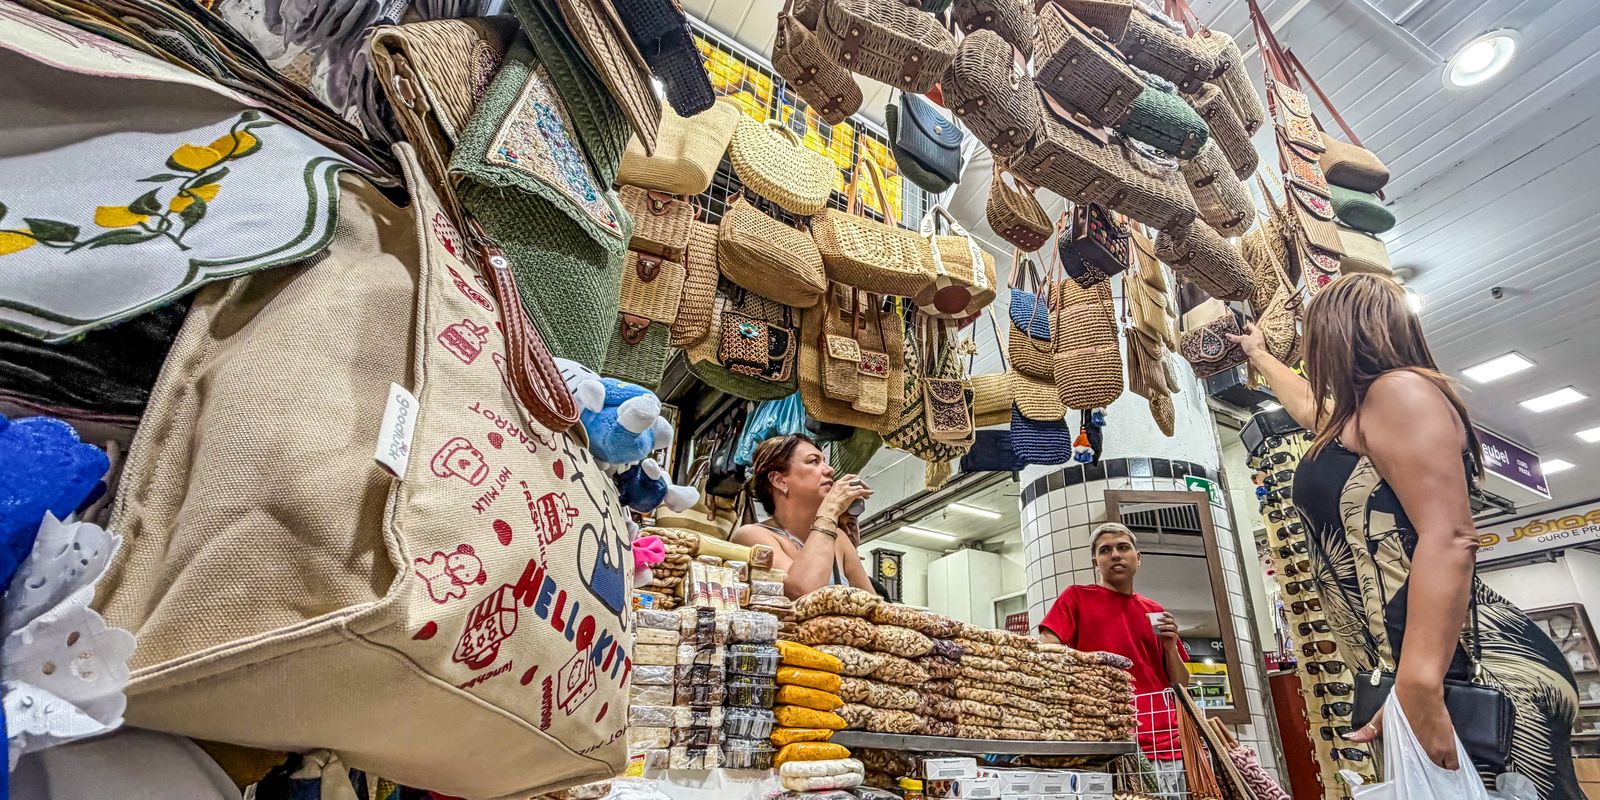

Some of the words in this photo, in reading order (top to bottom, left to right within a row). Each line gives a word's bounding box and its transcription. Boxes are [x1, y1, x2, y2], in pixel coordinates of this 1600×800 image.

[388, 394, 410, 460] goodluck
[468, 401, 537, 454] CARROT
[495, 466, 513, 491] HOT
[471, 485, 500, 515] MILK
[519, 480, 541, 532] FRESH
[537, 533, 548, 571] MILK
[1537, 531, 1570, 543] OURO
[1571, 529, 1581, 537] E
[1582, 525, 1600, 535] PR
[513, 558, 596, 650] HELLO
[592, 629, 632, 688] KITT
[579, 740, 604, 756] MIL
